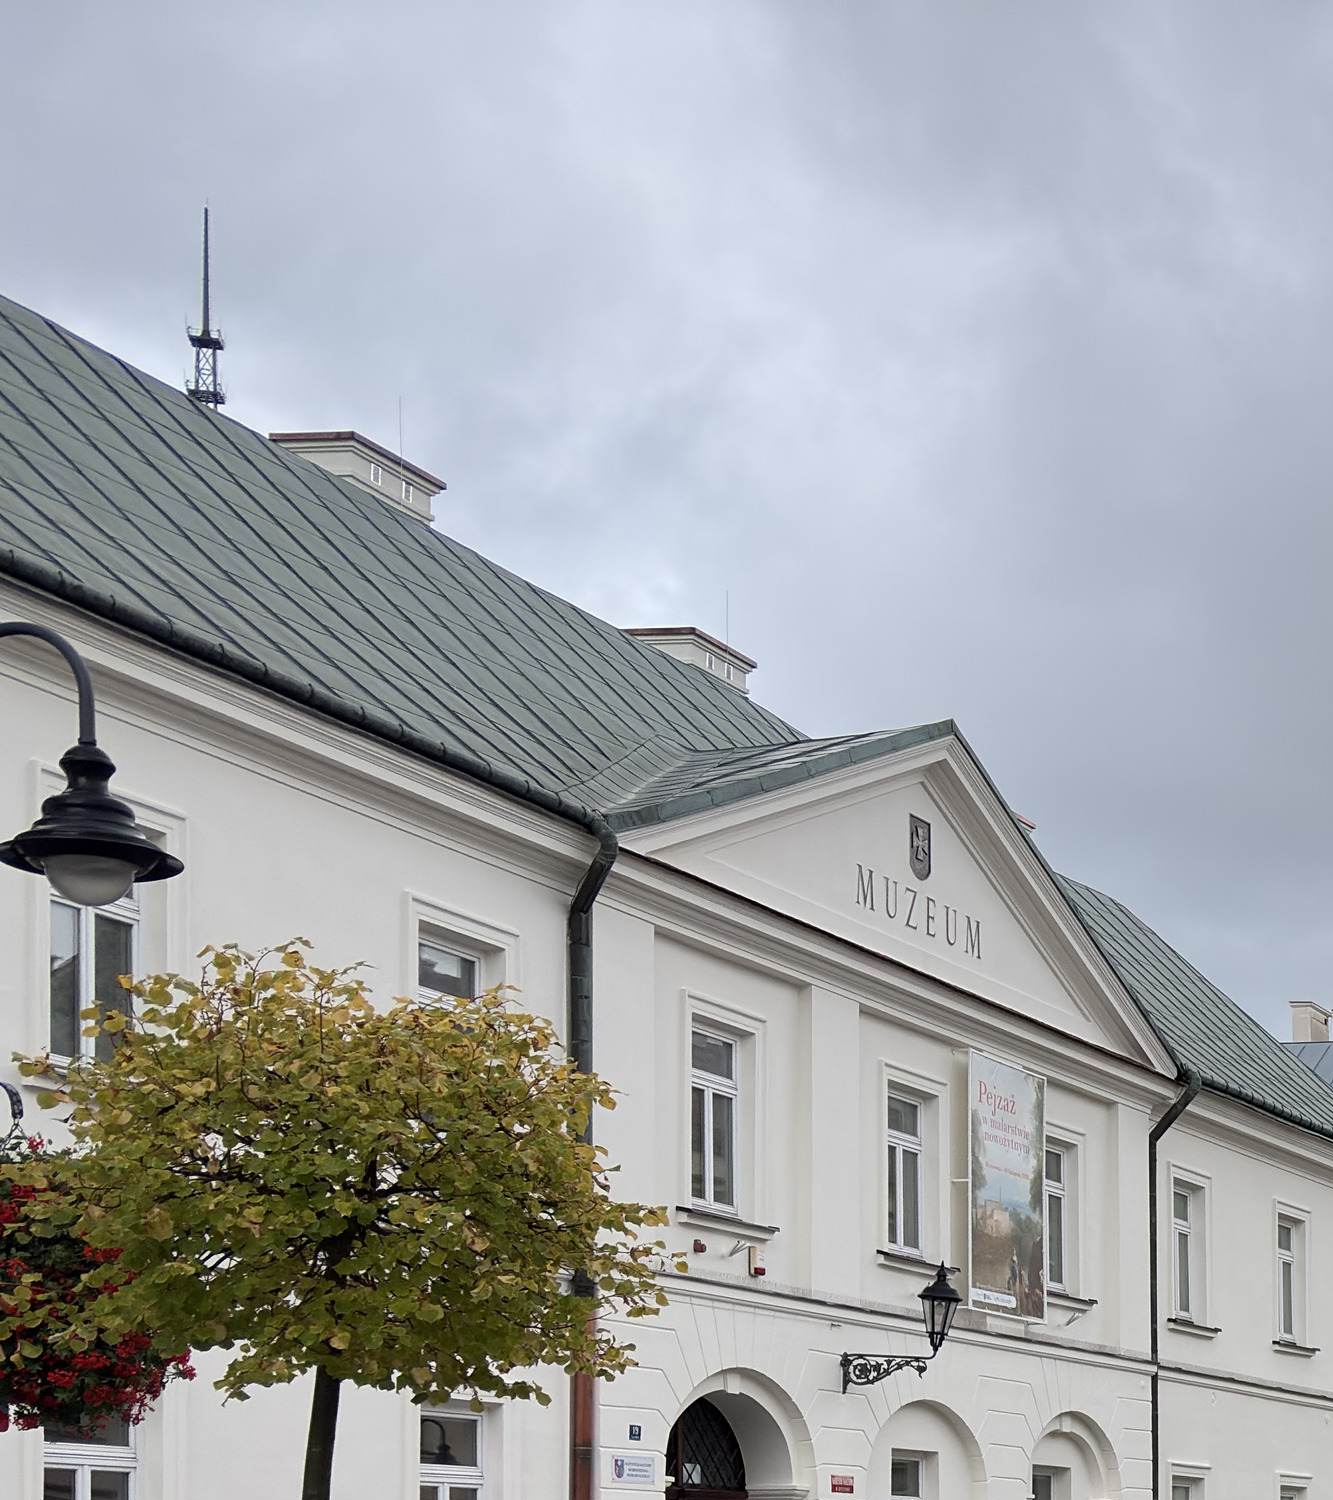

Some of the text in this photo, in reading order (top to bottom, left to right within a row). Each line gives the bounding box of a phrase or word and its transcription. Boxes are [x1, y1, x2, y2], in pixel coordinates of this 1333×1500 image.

[856, 863, 981, 959] MUZEUM
[978, 1080, 1016, 1115] Pejzaż
[984, 1131, 1030, 1154] nowożytnym
[990, 1116, 1030, 1140] malarstwie
